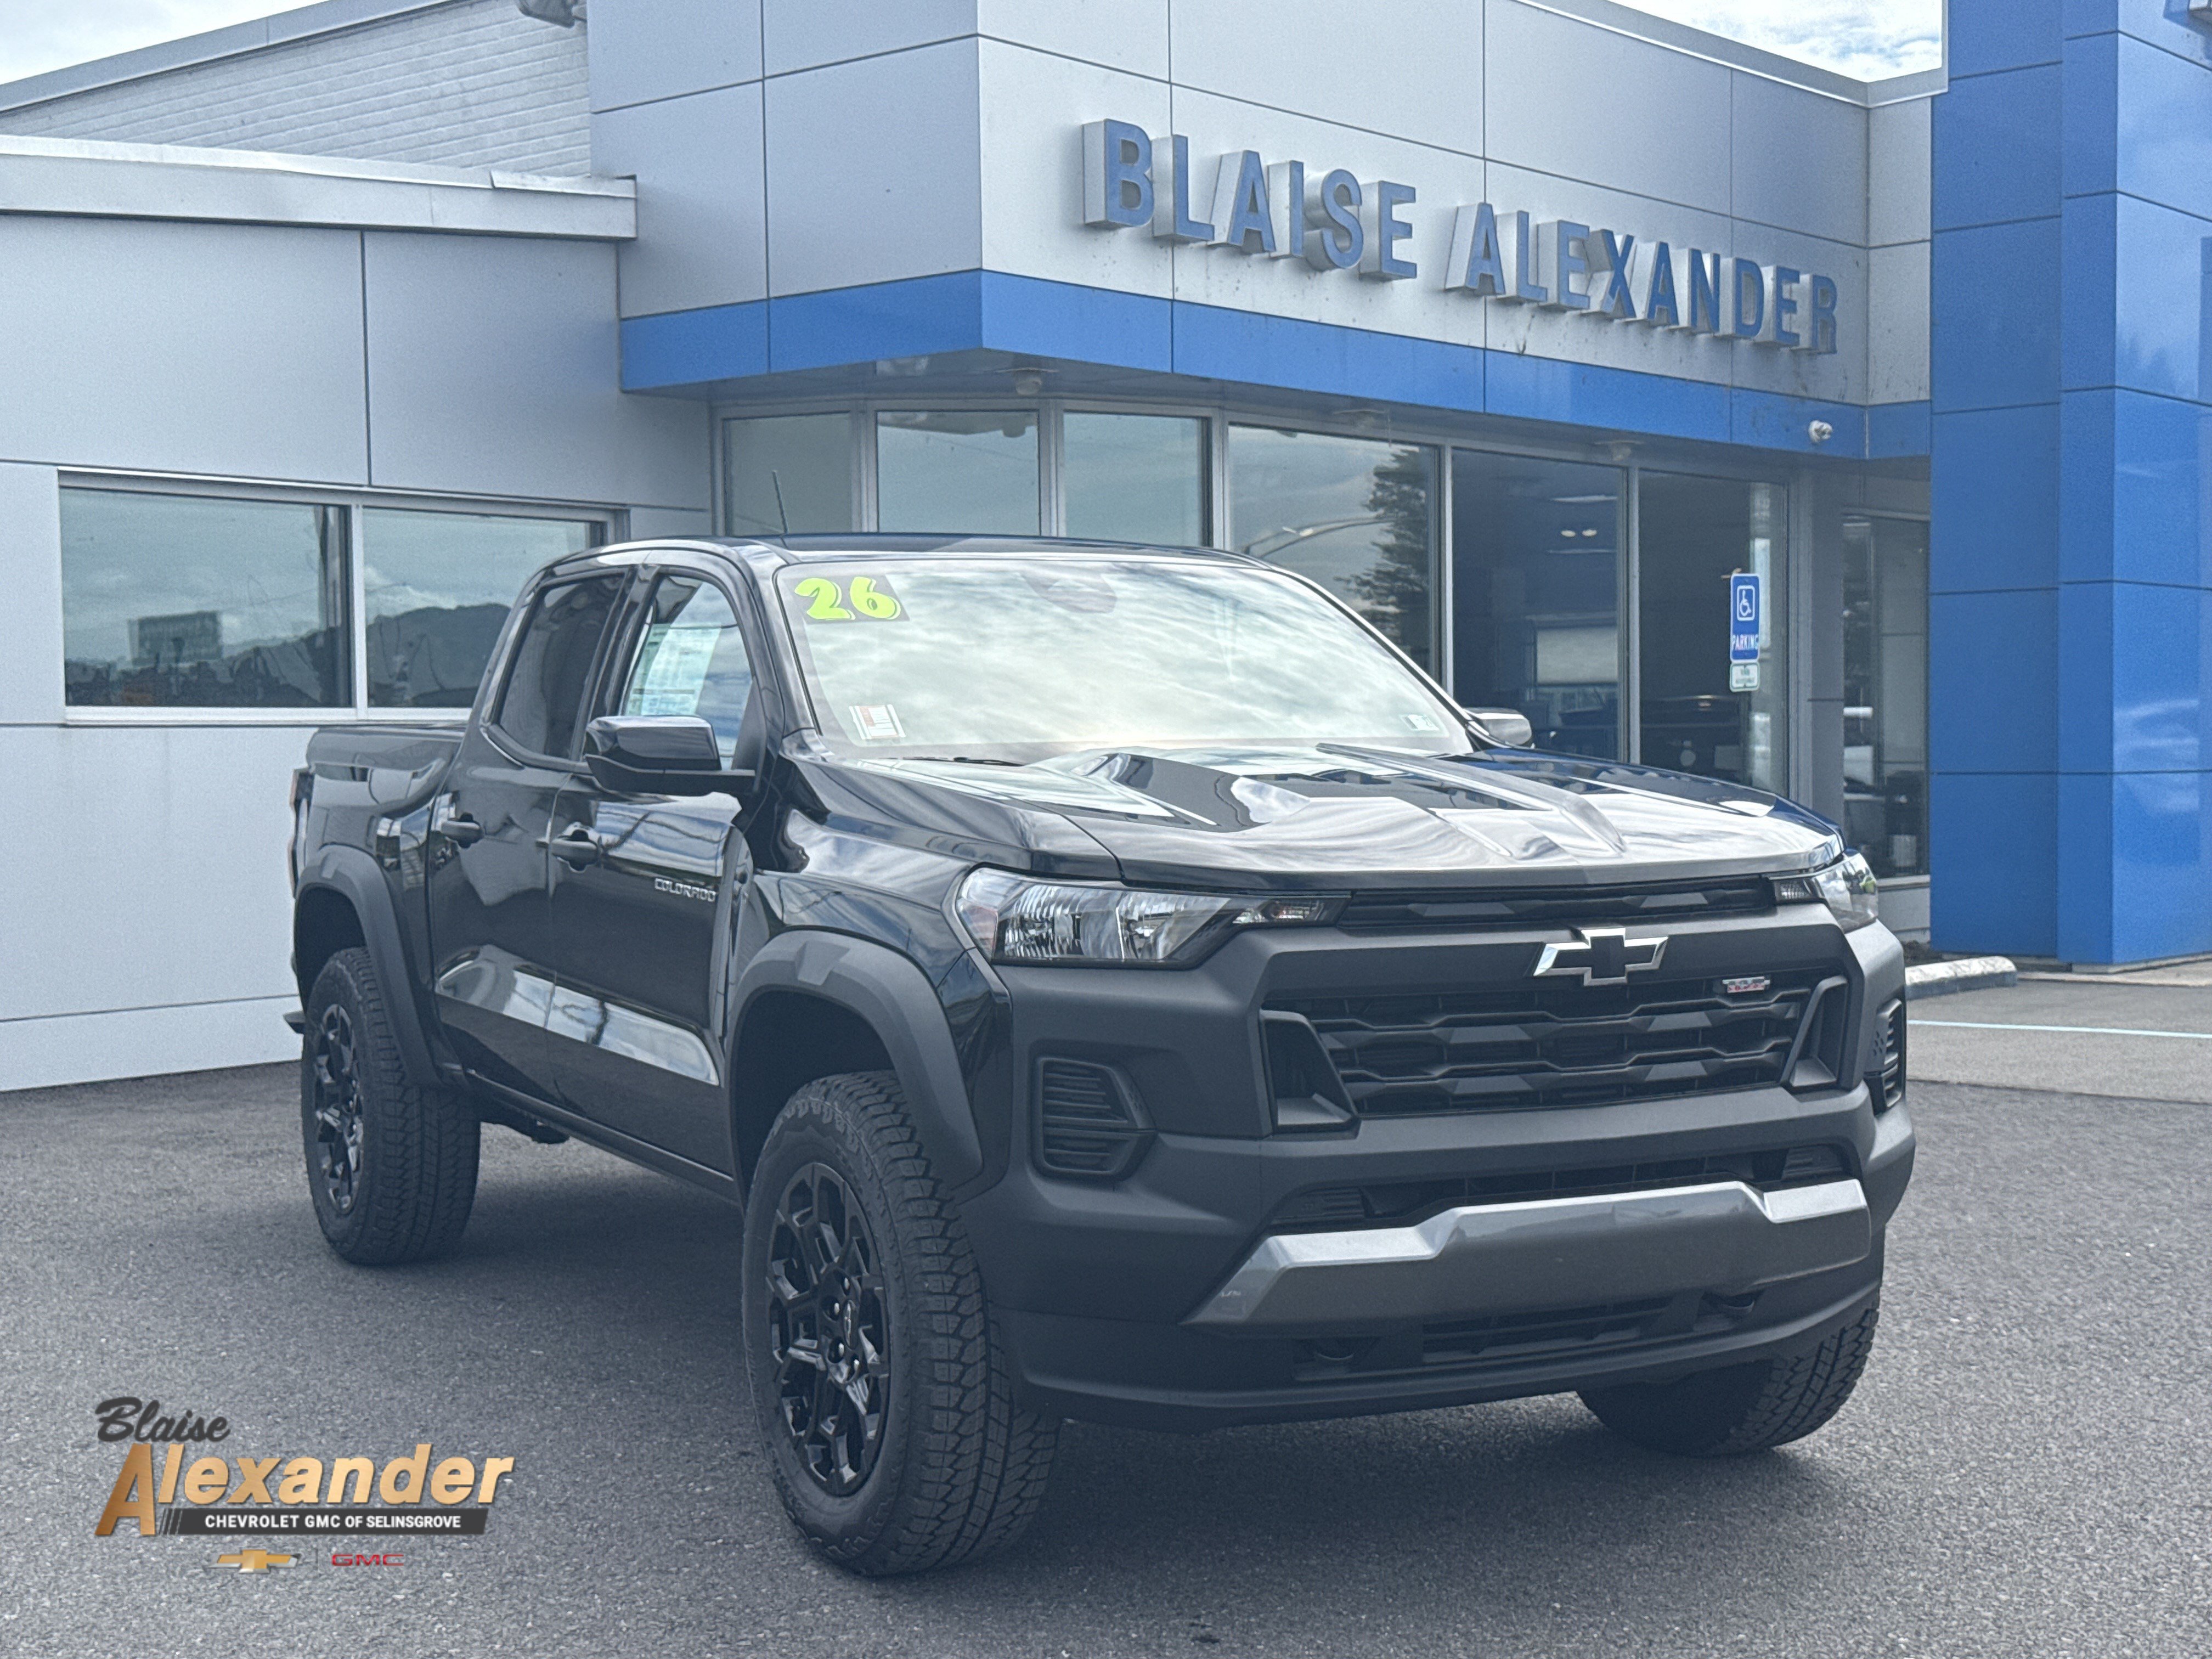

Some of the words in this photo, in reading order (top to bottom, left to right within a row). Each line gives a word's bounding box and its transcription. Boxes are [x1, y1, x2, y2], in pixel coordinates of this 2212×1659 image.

[1083, 118, 1418, 279] BLAISE
[1444, 202, 1837, 354] ALEXANDER
[794, 576, 901, 620] 26
[1731, 634, 1759, 650] PARKING
[654, 878, 716, 902] COLORADO
